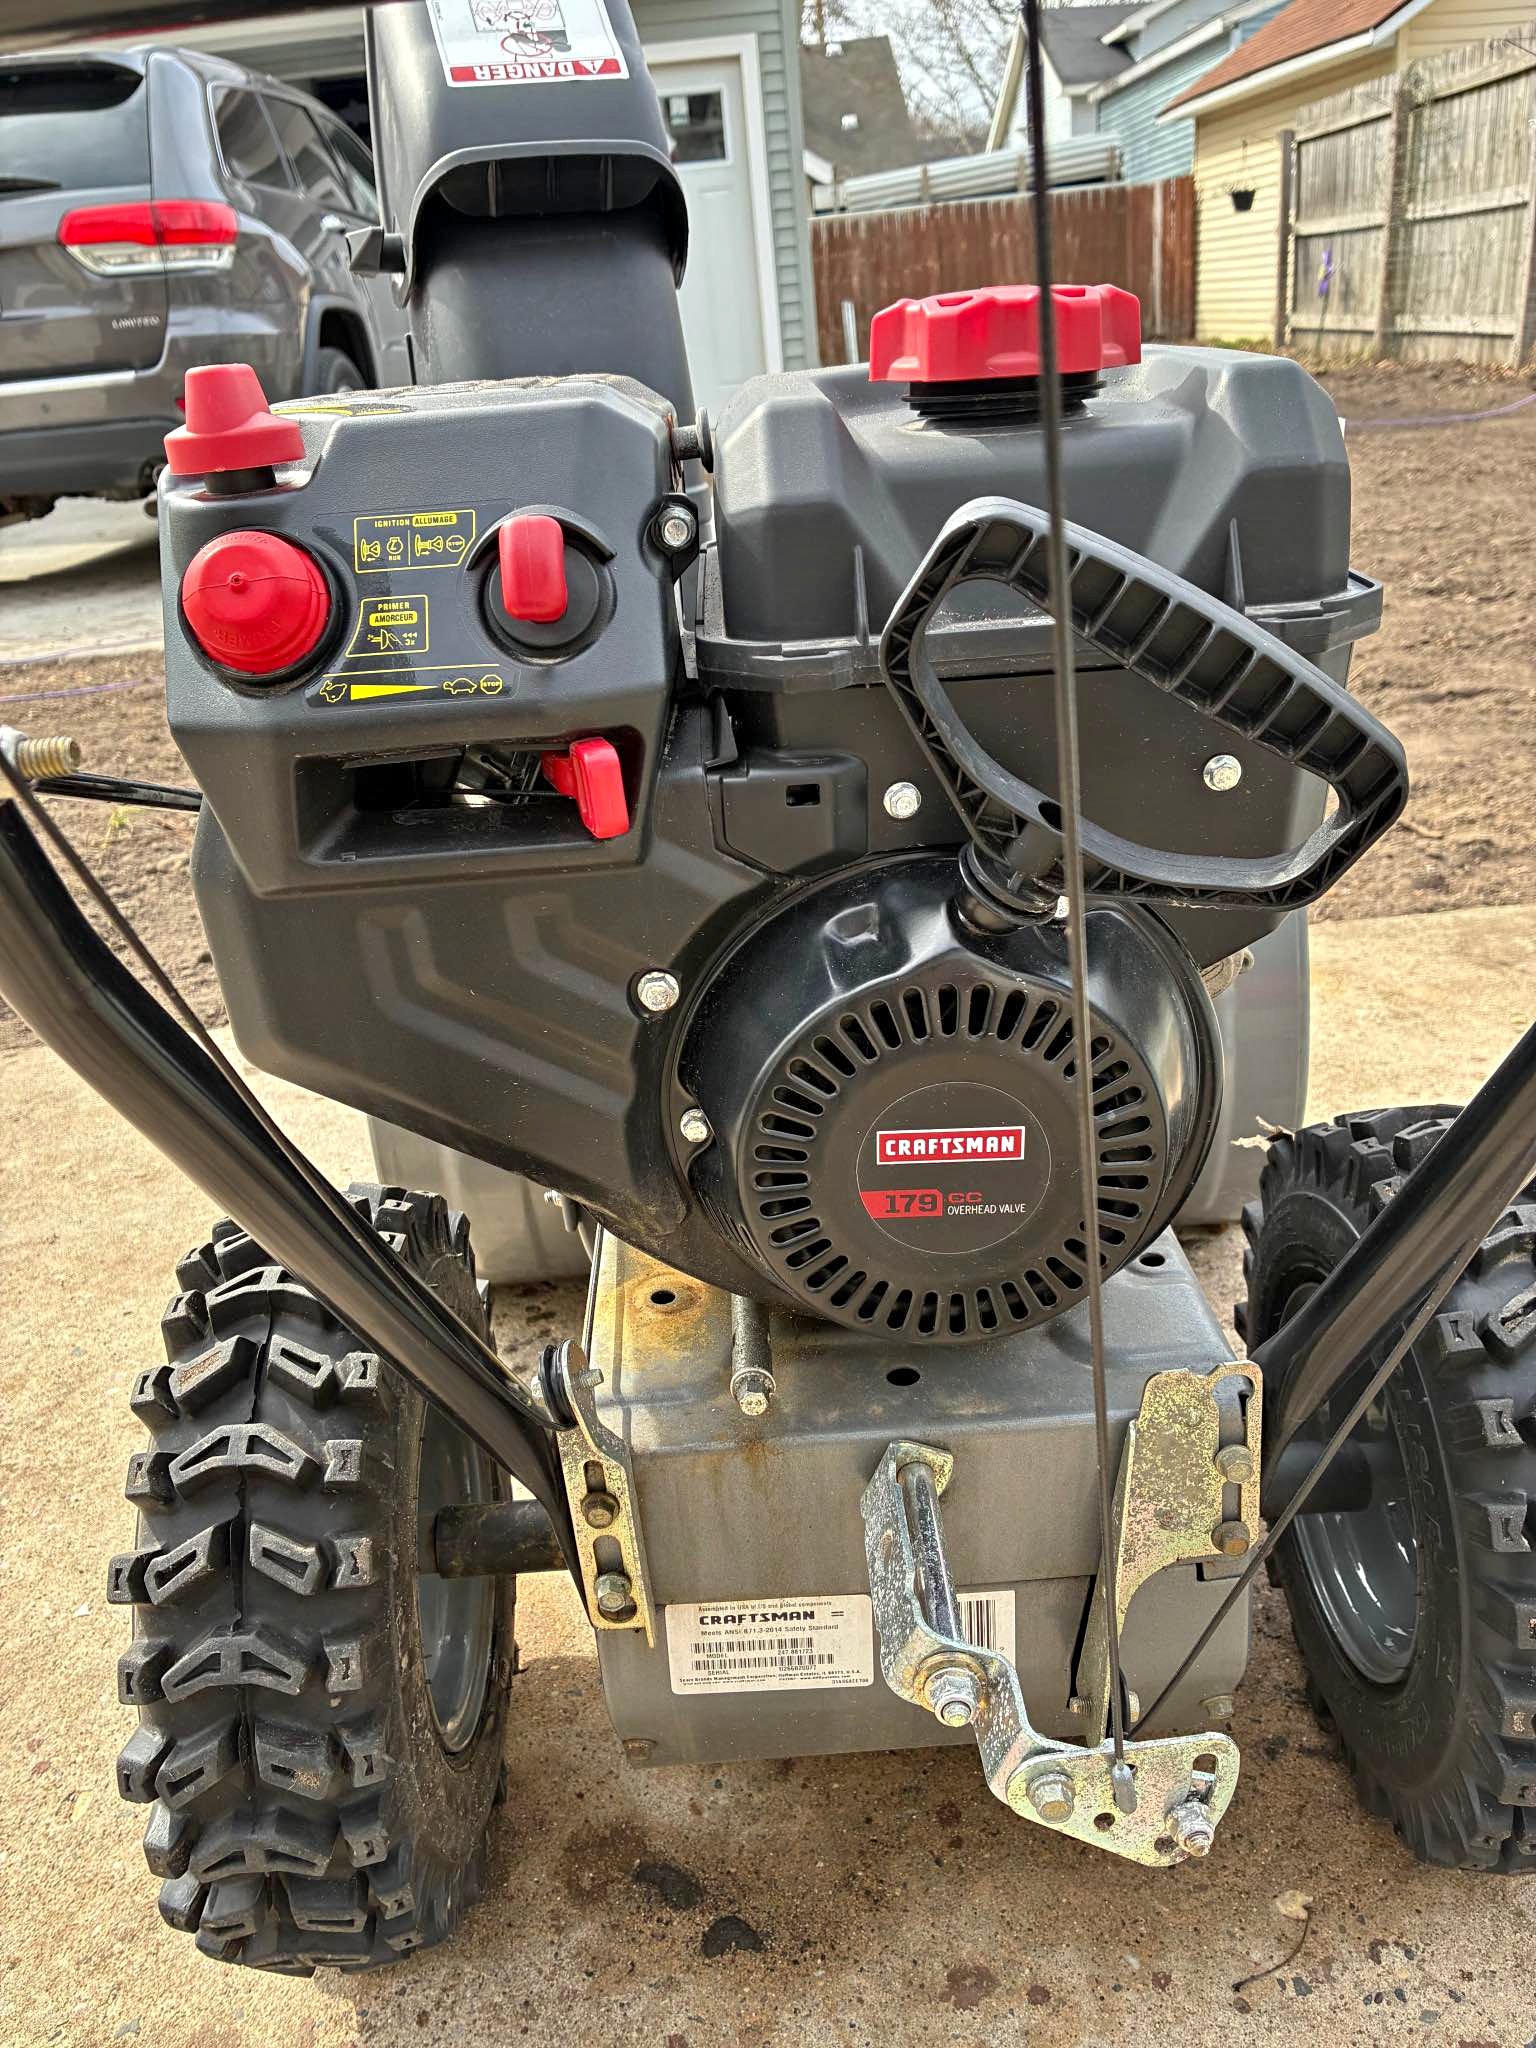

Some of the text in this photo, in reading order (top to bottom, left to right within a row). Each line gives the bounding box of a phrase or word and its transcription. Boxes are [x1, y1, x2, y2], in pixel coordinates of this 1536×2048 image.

[473, 60, 576, 81] DANGER
[111, 315, 161, 330] LIMITED
[374, 515, 454, 528] IGNITION ALLUMAGE
[377, 602, 410, 611] PRIMER
[374, 613, 414, 623] AMORCEUR
[482, 680, 500, 688] STOP
[885, 1135, 1015, 1156] CRAFTSMAN
[885, 1193, 938, 1214] 179
[947, 1203, 1027, 1216] OVERHEAD VALVE
[699, 1610, 815, 1625] CRAFTSMAN
